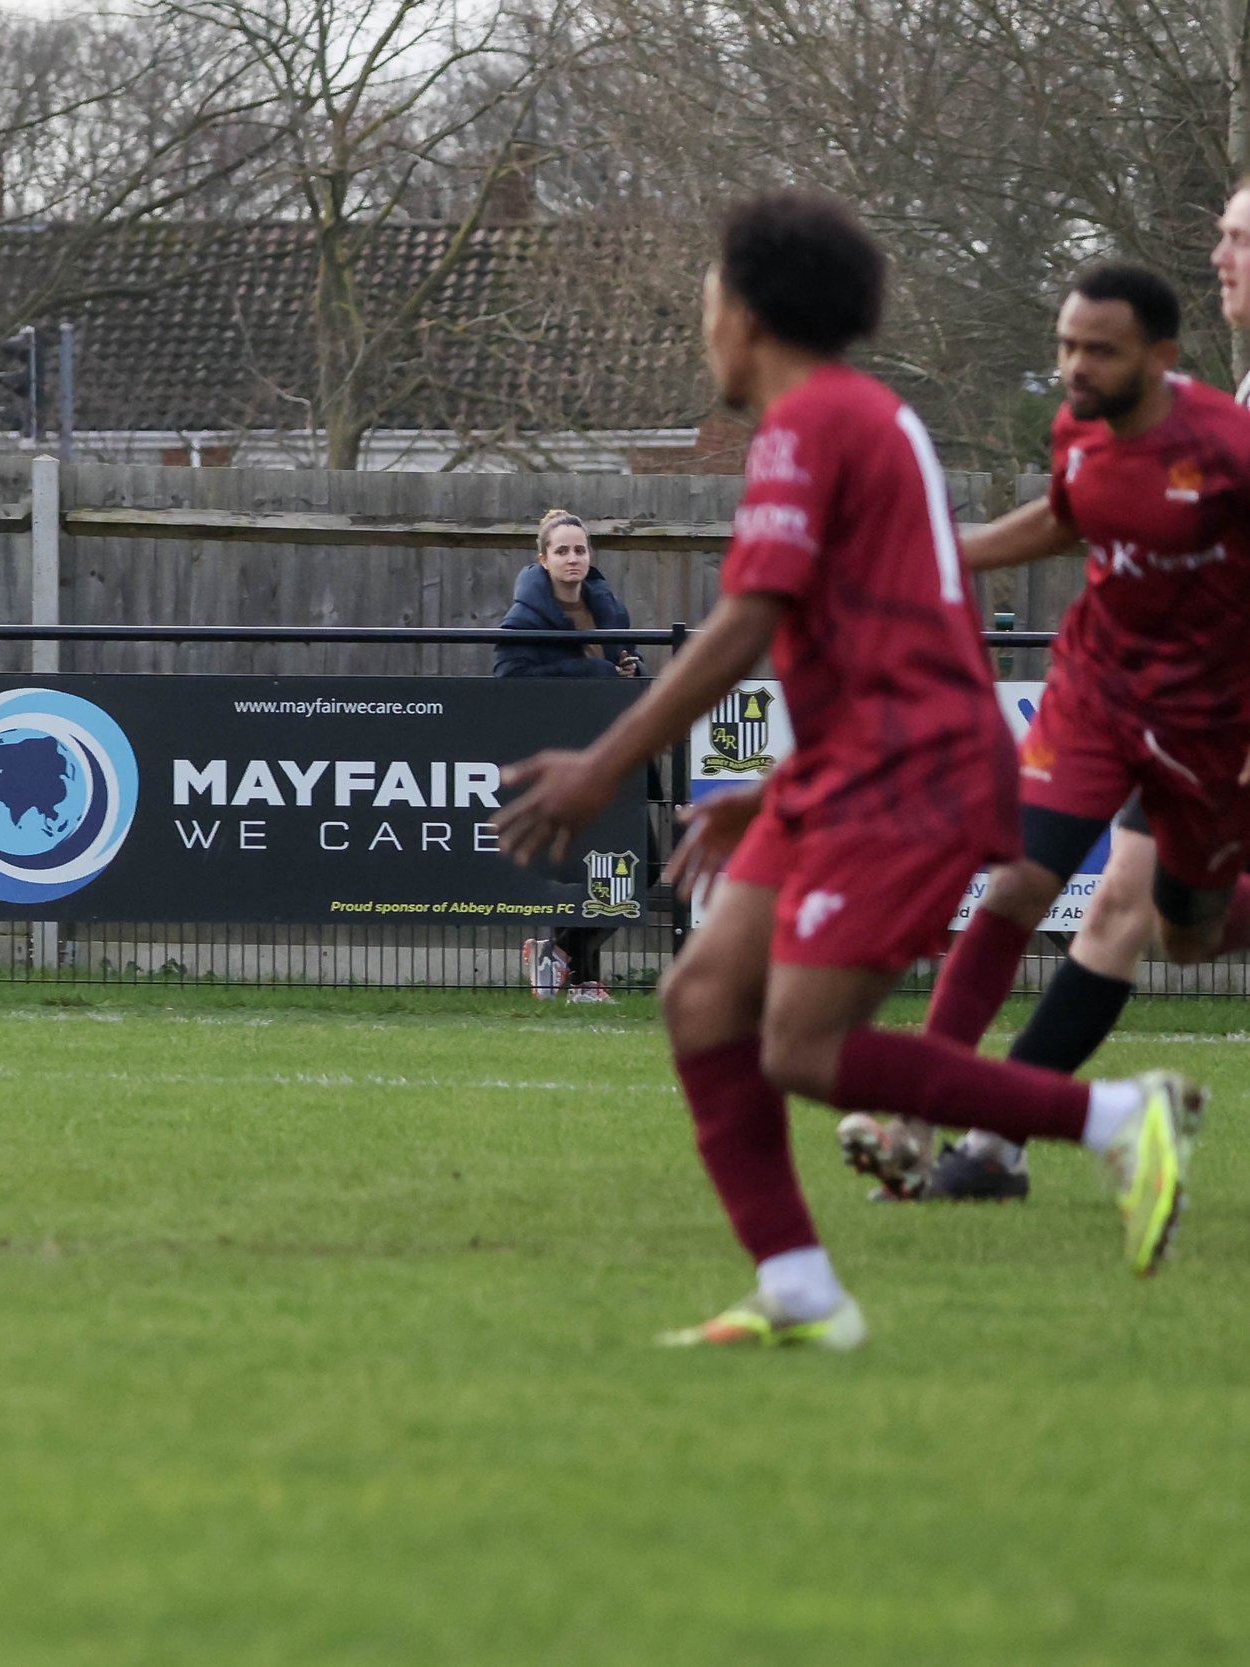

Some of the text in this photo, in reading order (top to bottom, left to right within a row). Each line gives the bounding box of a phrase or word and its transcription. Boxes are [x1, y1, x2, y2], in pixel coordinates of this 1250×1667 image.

[234, 698, 443, 717] www.mayfairwecare.com
[173, 759, 501, 808] MAYFAIR
[174, 820, 501, 851] WE CARE
[330, 901, 373, 914] Proud
[375, 903, 430, 915] sponsor
[432, 902, 447, 914] of
[449, 902, 493, 916] Abbey
[496, 902, 554, 916] Rangers
[556, 904, 575, 914] FC
